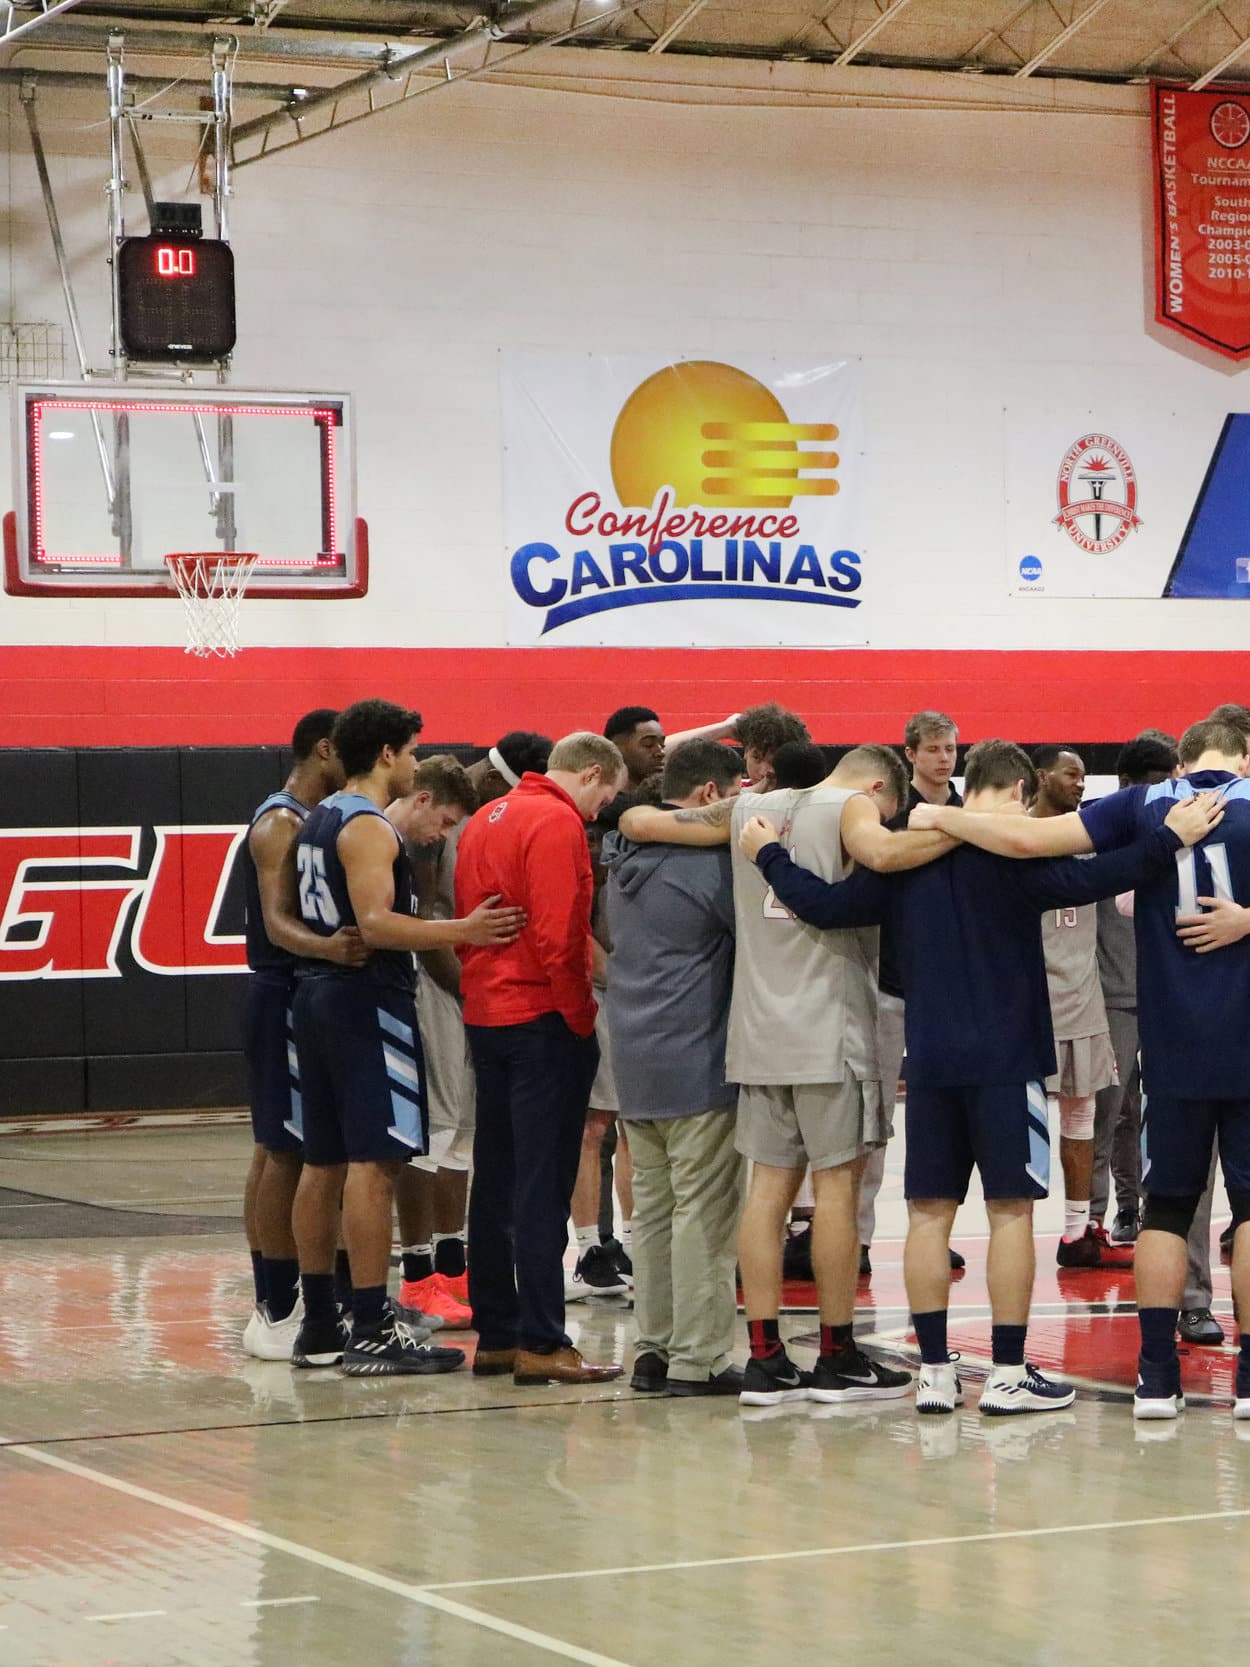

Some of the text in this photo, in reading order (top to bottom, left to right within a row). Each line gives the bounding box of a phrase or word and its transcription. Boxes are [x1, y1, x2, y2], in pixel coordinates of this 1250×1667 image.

[1163, 95, 1184, 313] WOMEN'S BASKETBALL
[158, 248, 194, 274] 0.0
[1060, 435, 1134, 481] NORTH GREENVILLE
[565, 491, 800, 556] Conference
[1067, 523, 1128, 552] UNIVERSITY
[510, 539, 863, 608] CAROLINAS
[297, 843, 341, 929] 25
